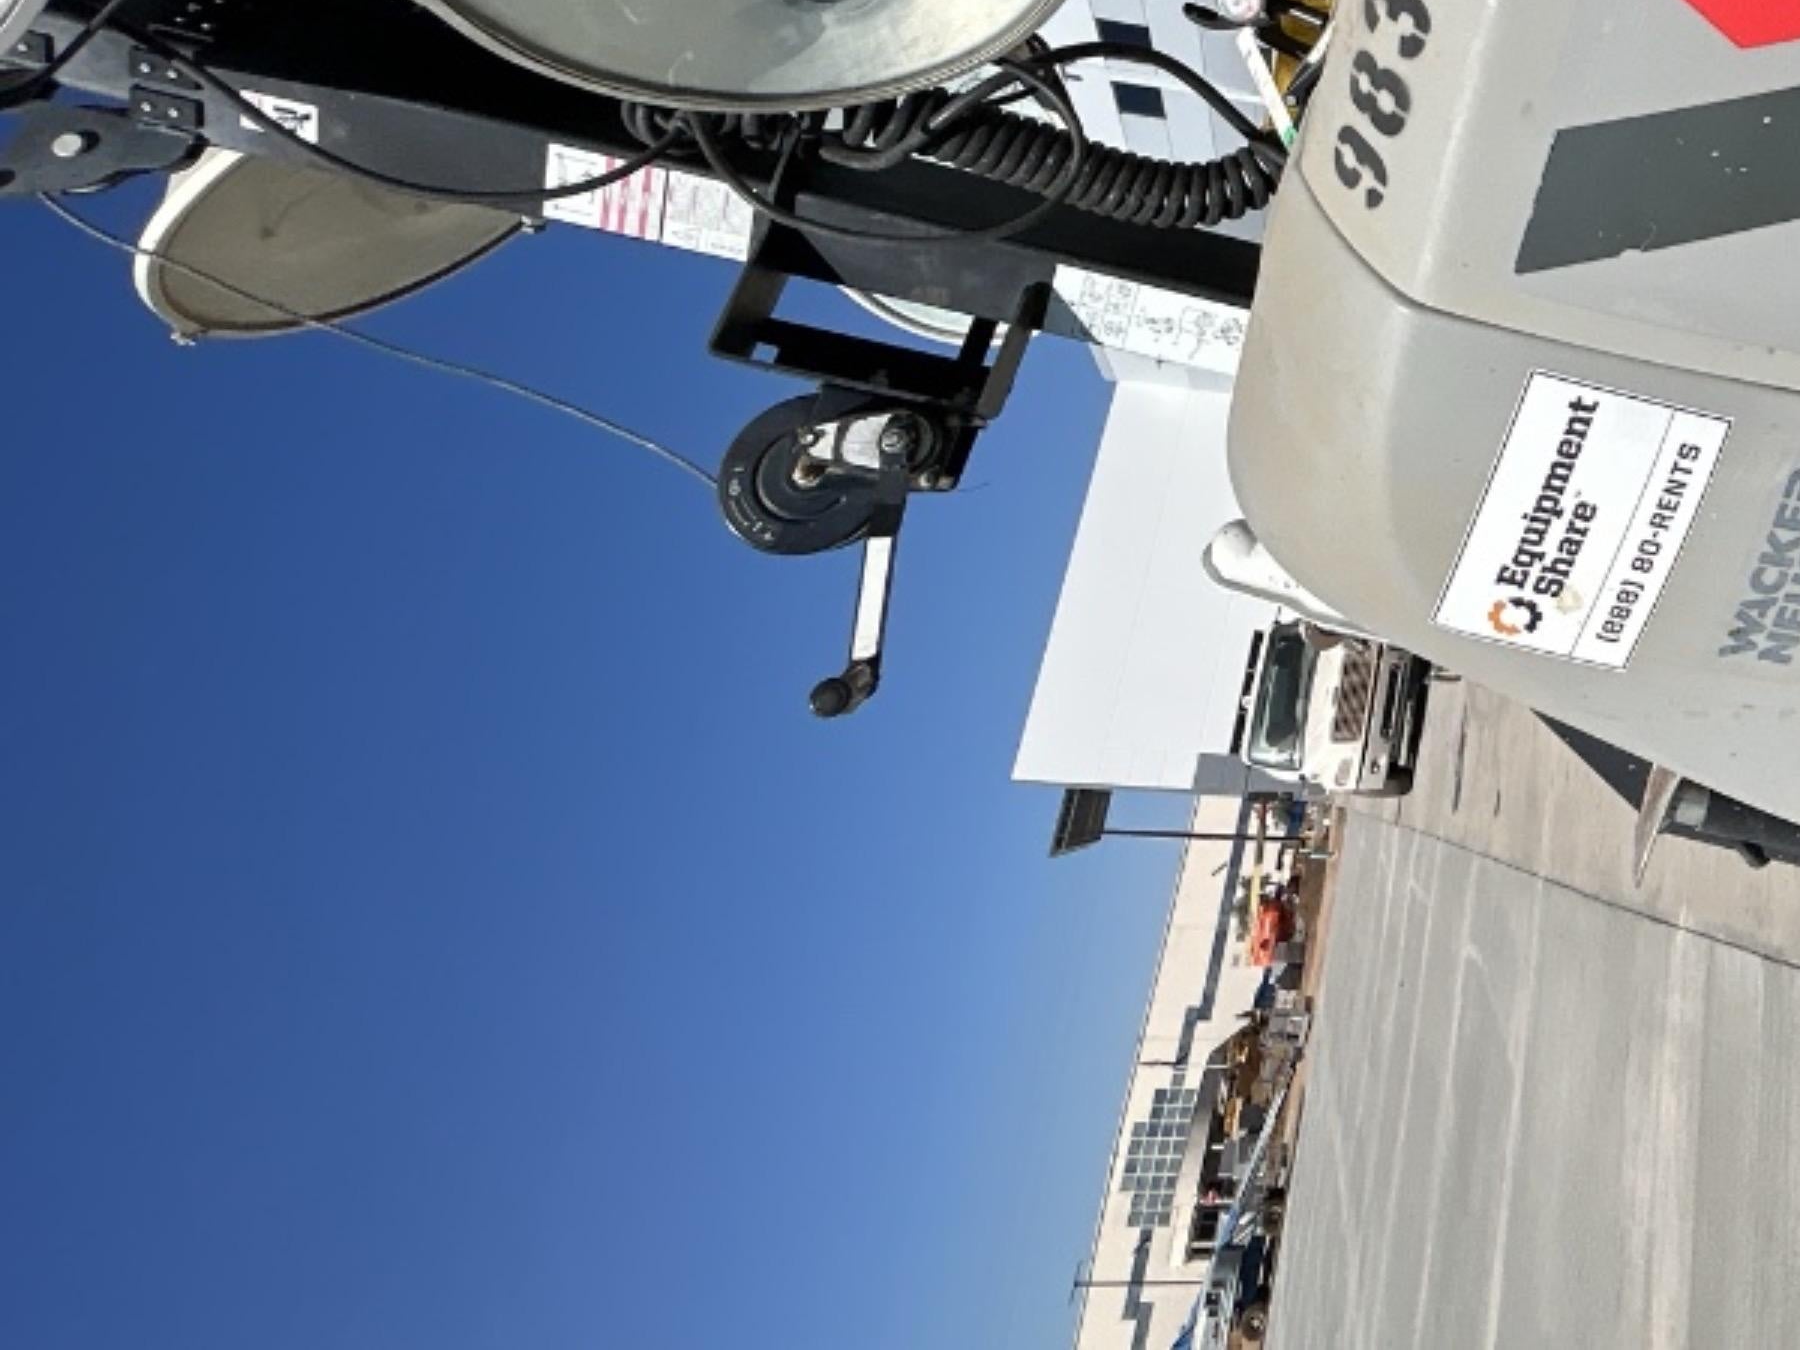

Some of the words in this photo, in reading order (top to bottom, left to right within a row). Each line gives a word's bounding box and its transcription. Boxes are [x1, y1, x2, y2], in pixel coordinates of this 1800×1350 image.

[1494, 395, 1600, 590] Equipment
[1532, 500, 1598, 598] Share
[1595, 578, 1645, 643] (888)
[1631, 441, 1702, 574] 80-RENTS
